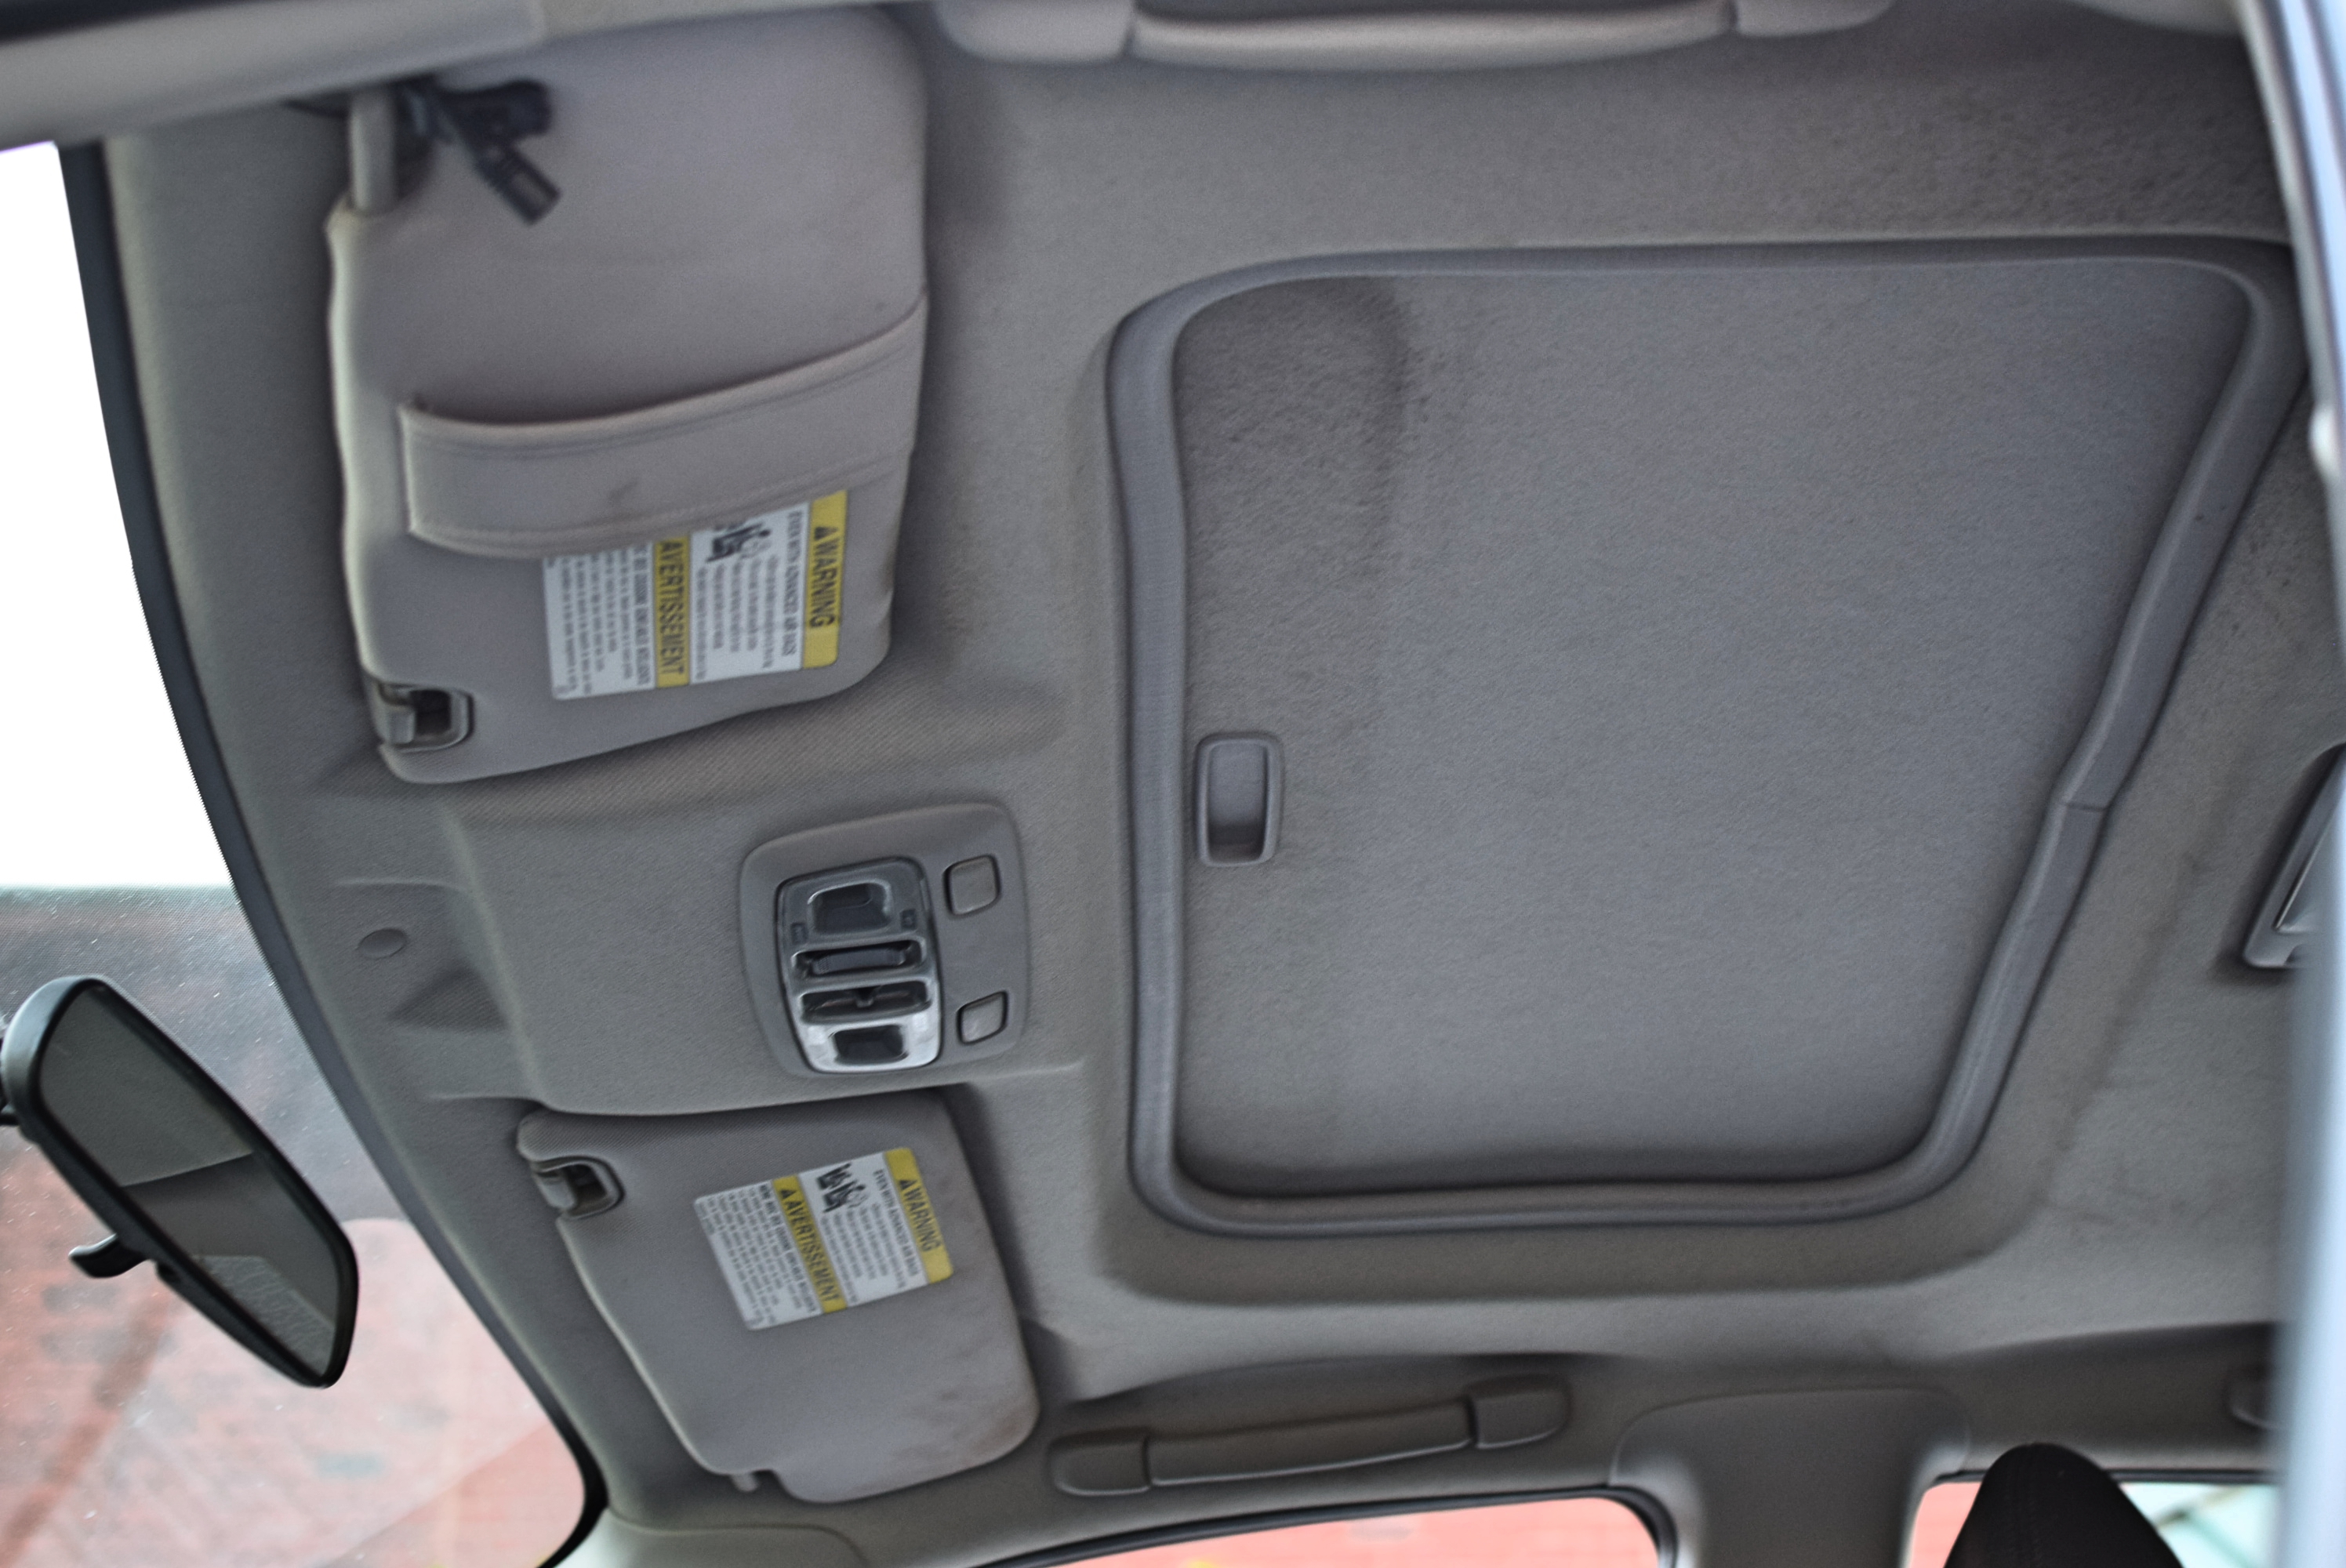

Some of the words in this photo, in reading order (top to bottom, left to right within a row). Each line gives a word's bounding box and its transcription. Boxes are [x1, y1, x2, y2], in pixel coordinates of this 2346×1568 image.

[659, 541, 684, 676] AVERTISSEMENT
[810, 537, 840, 628] WARNING
[783, 1200, 840, 1301] AVERTISSEMENT
[902, 1186, 940, 1251] WARNING
